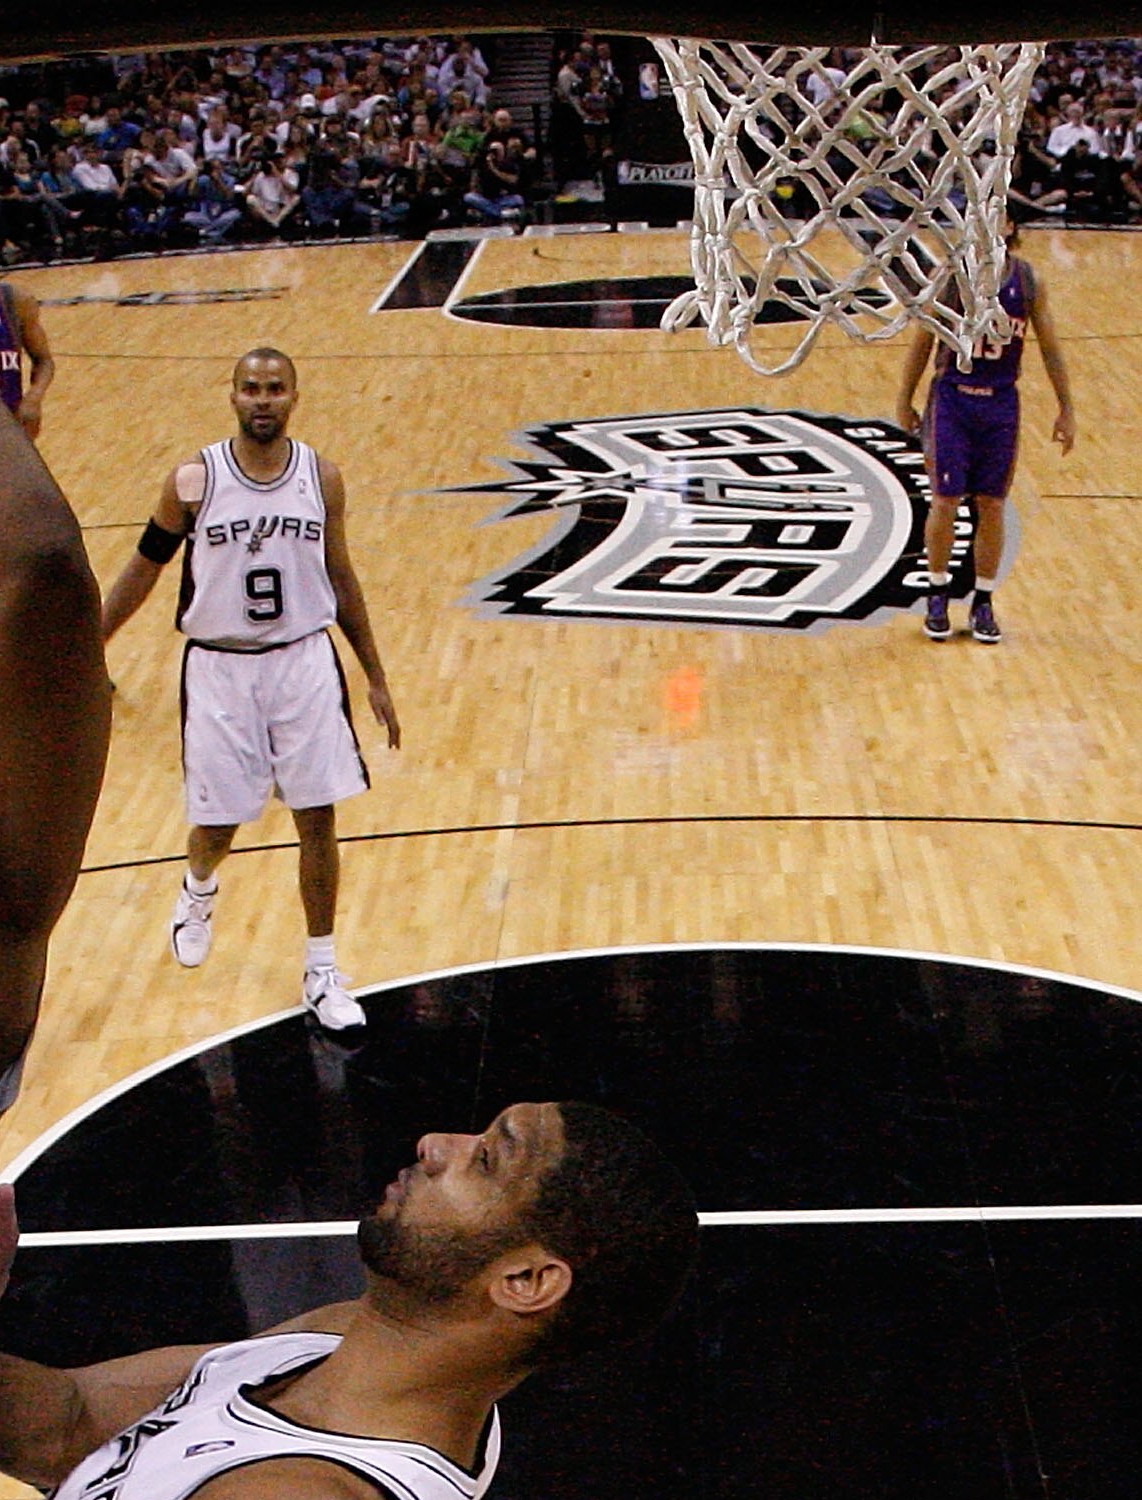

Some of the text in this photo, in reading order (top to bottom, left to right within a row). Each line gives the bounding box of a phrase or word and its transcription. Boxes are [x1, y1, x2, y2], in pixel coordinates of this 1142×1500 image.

[205, 515, 322, 556] SPURS
[593, 415, 875, 600] SPURS
[243, 564, 287, 624] 9
